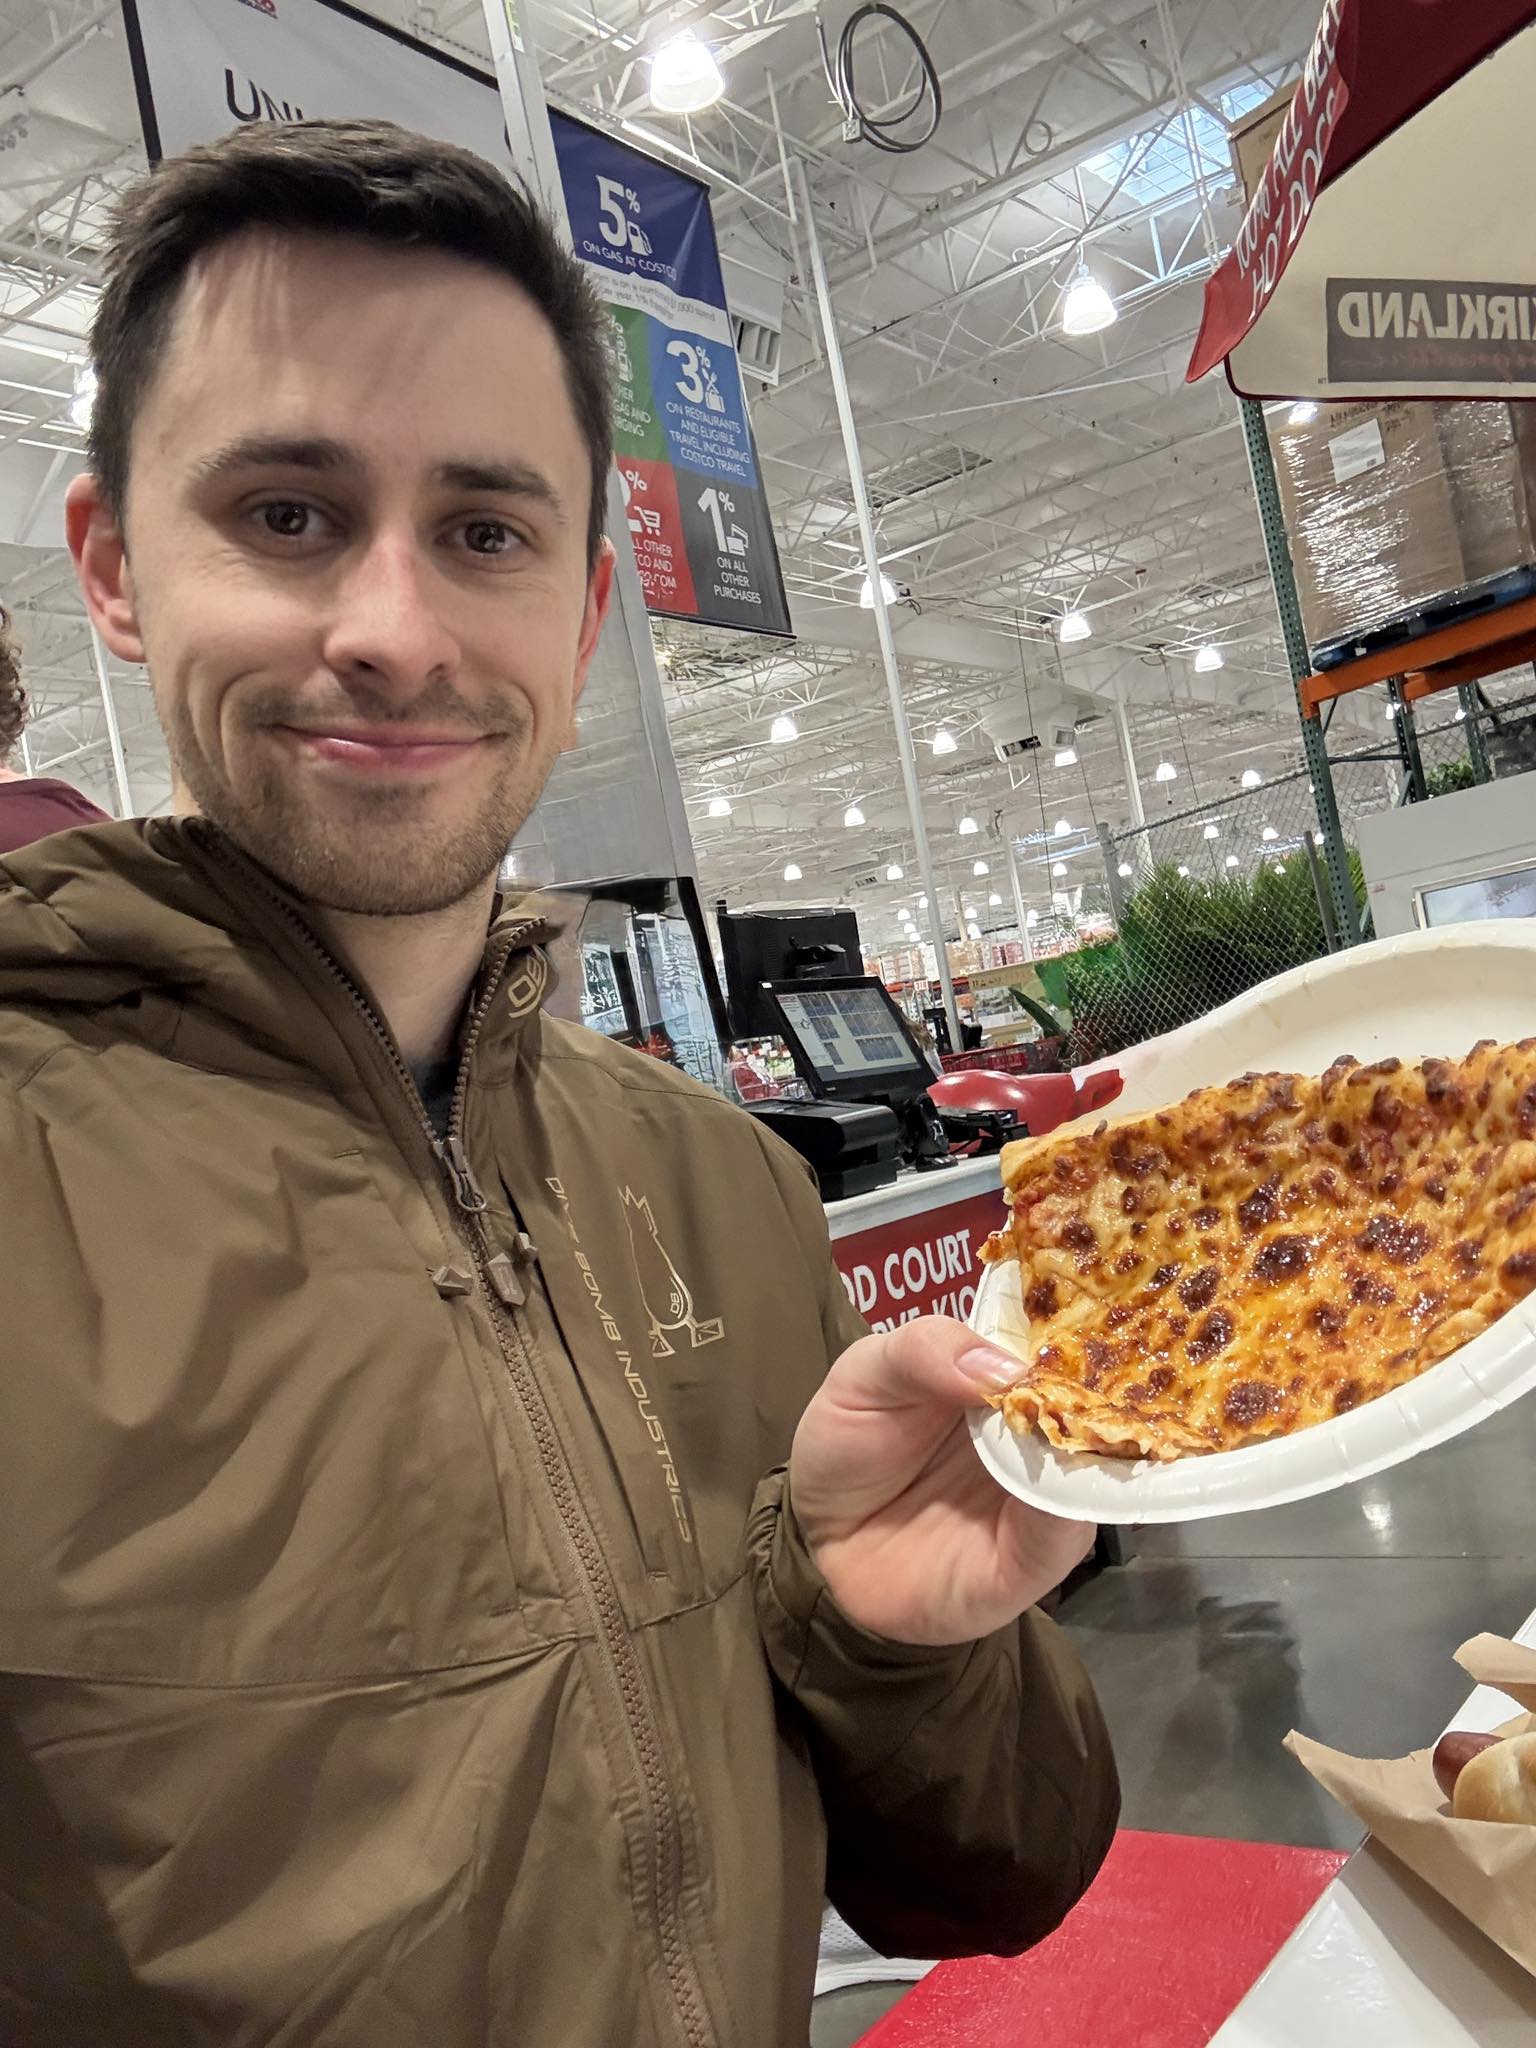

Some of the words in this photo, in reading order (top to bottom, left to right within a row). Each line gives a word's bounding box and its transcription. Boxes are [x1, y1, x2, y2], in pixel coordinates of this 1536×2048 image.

[583, 240, 601, 255] ON
[602, 247, 623, 264] GAS
[625, 255, 636, 268] AT
[638, 259, 677, 281] COSTCO
[666, 340, 711, 403] 3%
[631, 407, 651, 423] AND
[666, 402, 683, 414] ON
[684, 405, 741, 434] RESTAURANTS
[681, 419, 699, 434] AND
[700, 425, 736, 446] ELIGIBLE
[680, 447, 715, 468] COSTCO
[715, 458, 747, 477] TRAVEL
[703, 440, 751, 464] INCLUDING
[697, 487, 735, 552] 1%
[643, 539, 673, 558] OTHER
[653, 557, 673, 573] AND
[717, 556, 731, 569] ON
[733, 560, 749, 574] ALL
[721, 571, 751, 587] OTHER
[713, 584, 762, 604] PURCHASES
[884, 1229, 972, 1300] COURT
[574, 1250, 621, 1341] BOMB
